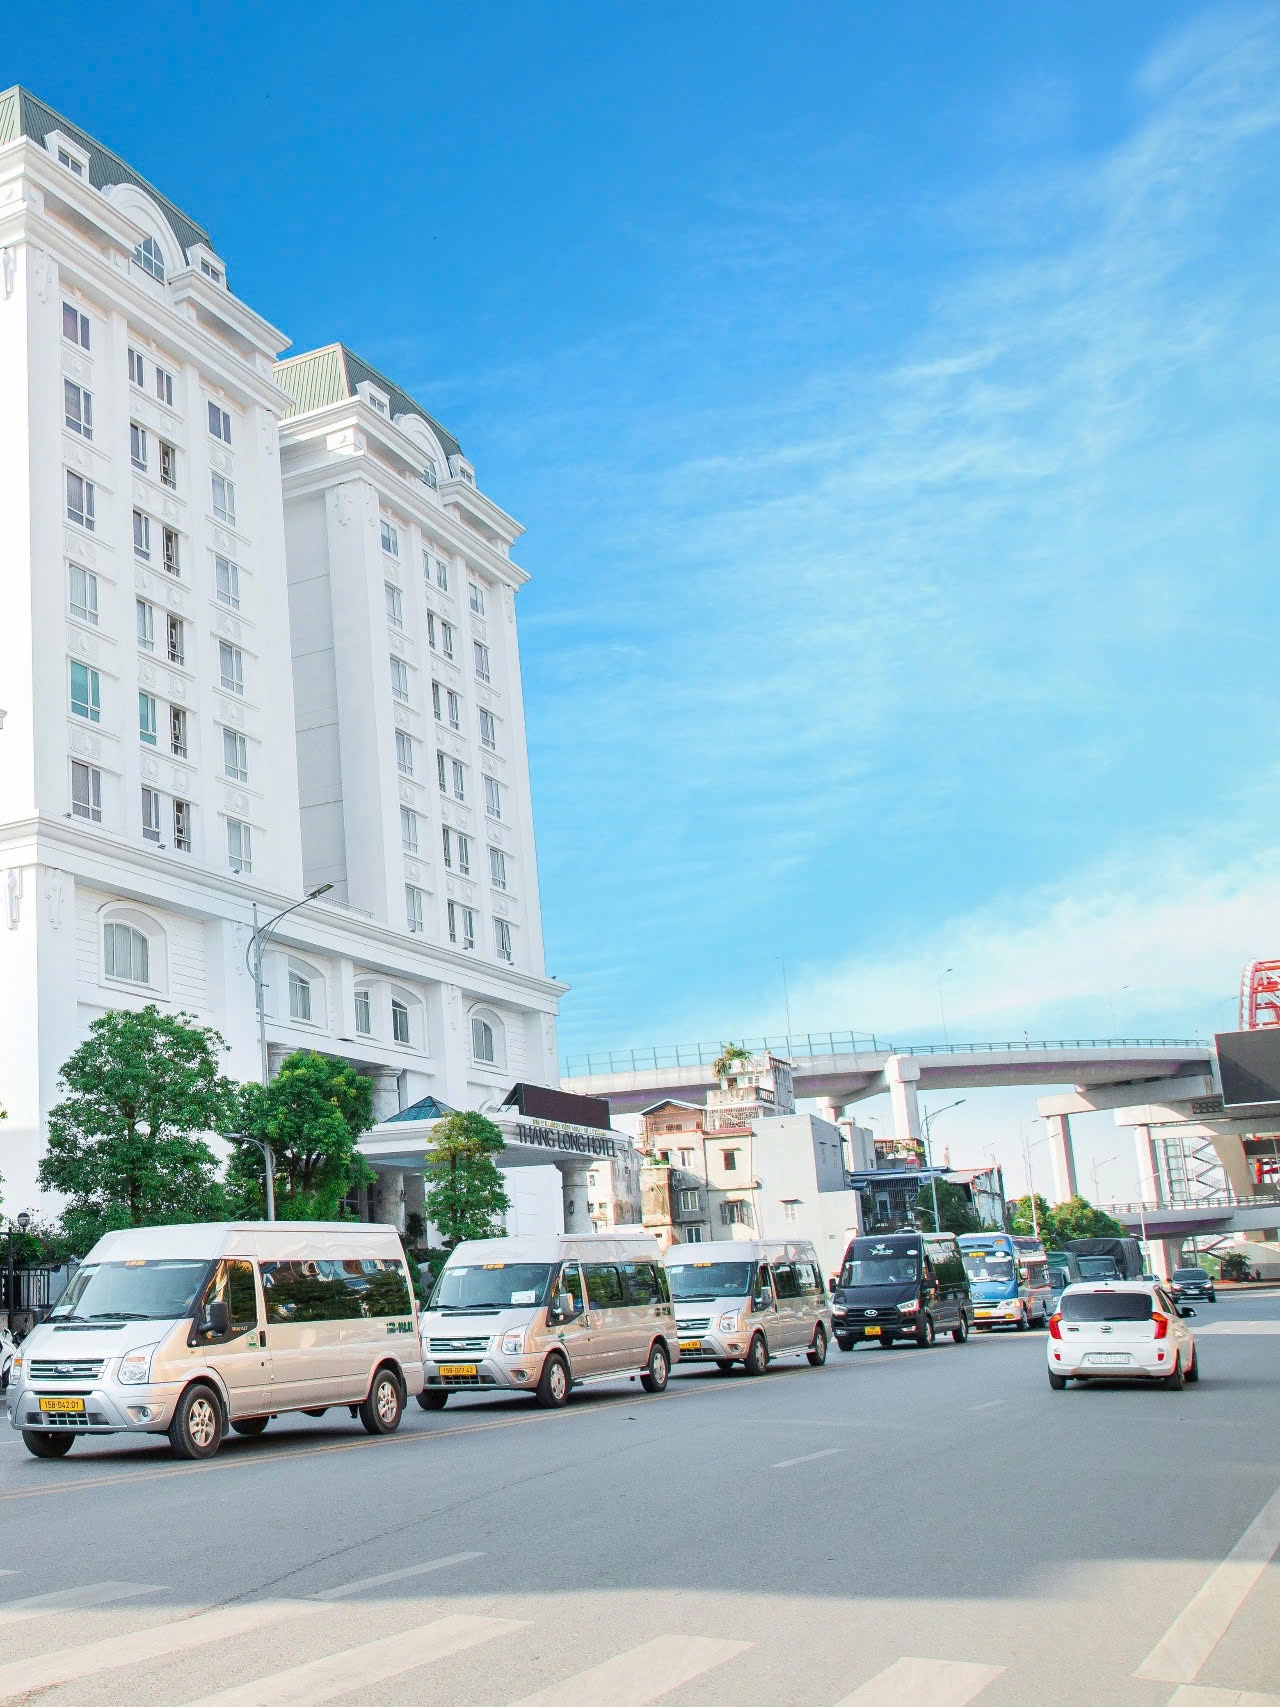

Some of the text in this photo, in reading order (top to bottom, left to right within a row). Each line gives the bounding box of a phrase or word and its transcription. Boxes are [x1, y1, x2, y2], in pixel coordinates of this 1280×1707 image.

[557, 1130, 586, 1153] LONG
[587, 1135, 619, 1159] HOTEL
[44, 1400, 79, 1409] 15B-042.01
